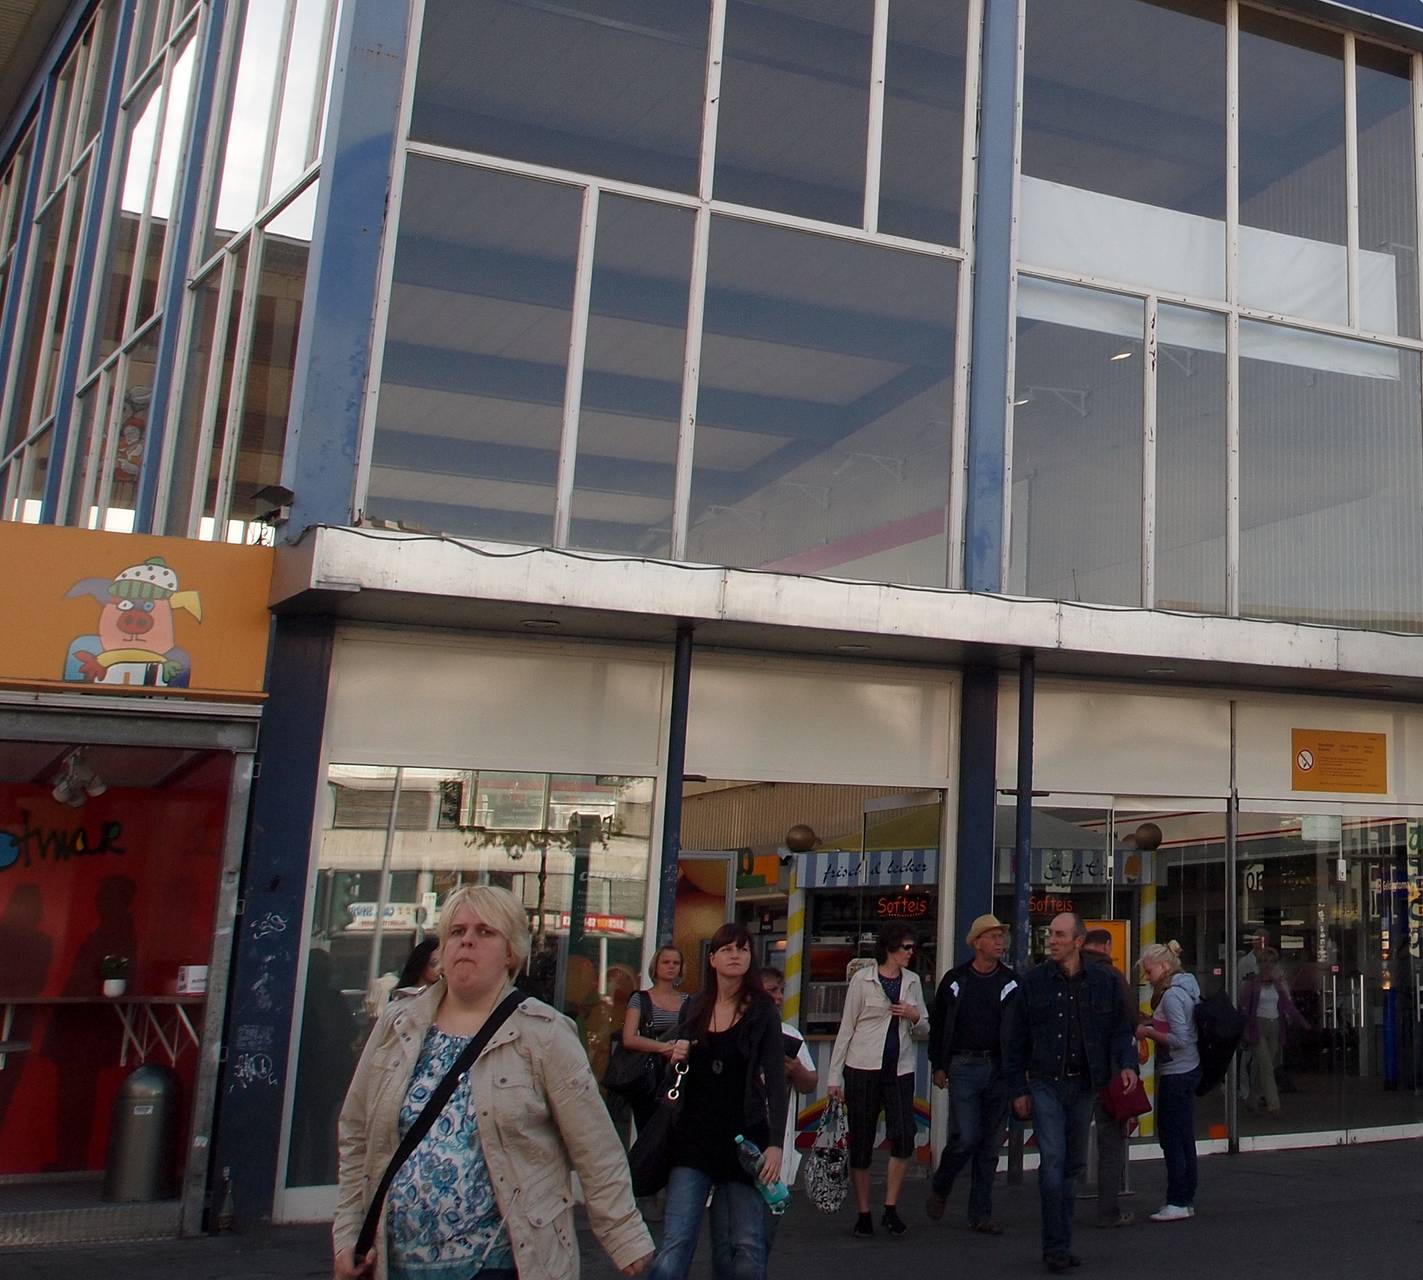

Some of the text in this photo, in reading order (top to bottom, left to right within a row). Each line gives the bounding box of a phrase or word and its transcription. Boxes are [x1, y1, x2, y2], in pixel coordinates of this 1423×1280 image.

[887, 857, 928, 875] lecker
[877, 896, 928, 914] Softeis
[1029, 895, 1074, 912] Softeis
